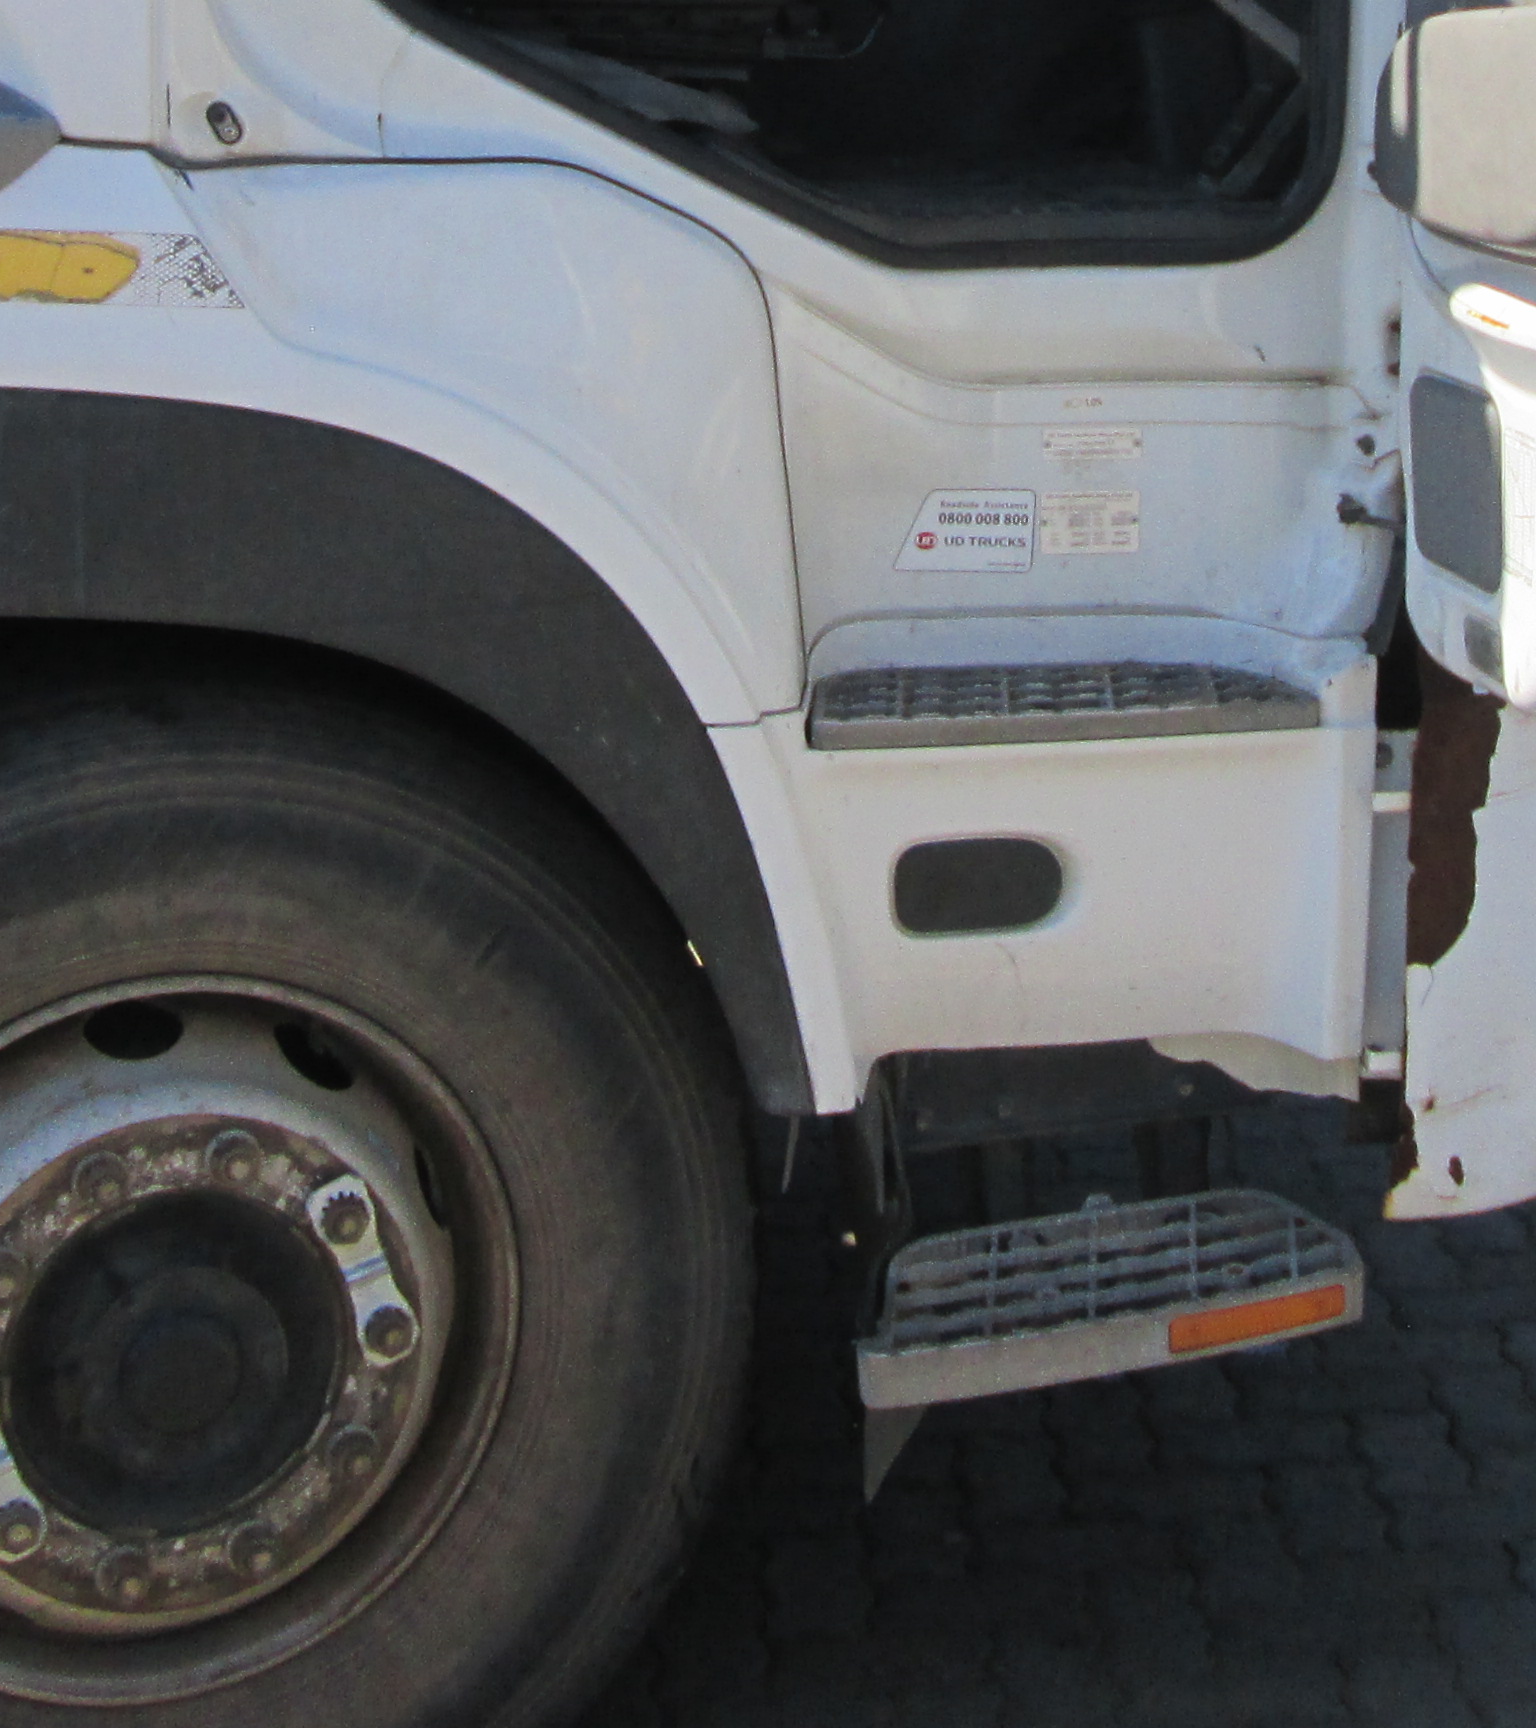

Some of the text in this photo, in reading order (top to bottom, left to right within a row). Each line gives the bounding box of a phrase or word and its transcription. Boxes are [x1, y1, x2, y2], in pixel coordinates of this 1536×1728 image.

[938, 512, 1029, 526] 0800 008 800
[944, 536, 965, 547] UD
[968, 536, 1026, 548] TRUCKS
